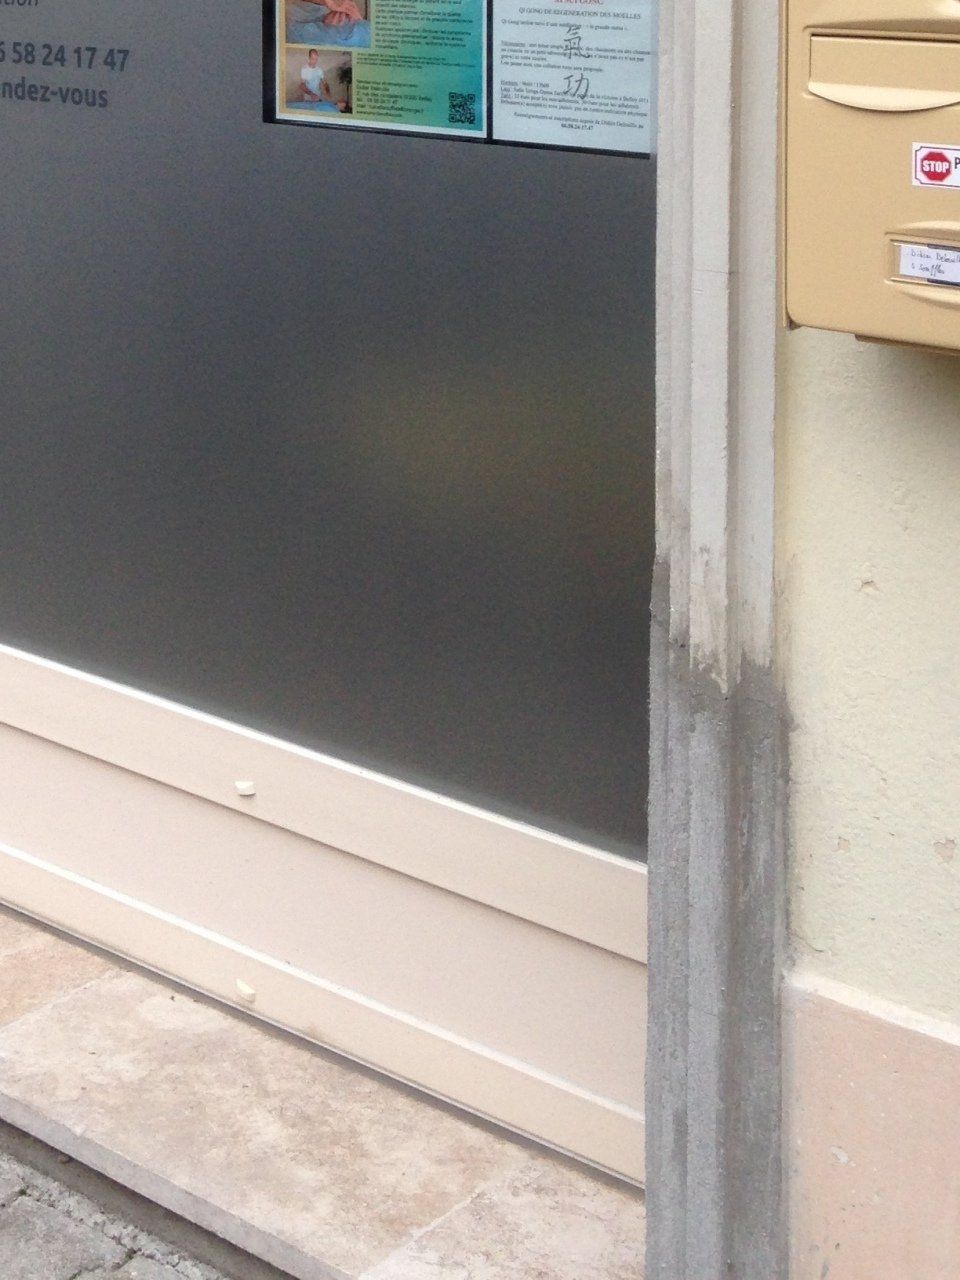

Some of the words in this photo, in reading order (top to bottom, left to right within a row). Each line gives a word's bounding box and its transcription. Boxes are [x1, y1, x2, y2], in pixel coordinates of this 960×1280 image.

[12, 42, 36, 64] 58
[42, 44, 66, 68] 24
[73, 46, 96, 70] 17
[104, 48, 130, 72] 47
[922, 160, 950, 172] STOP
